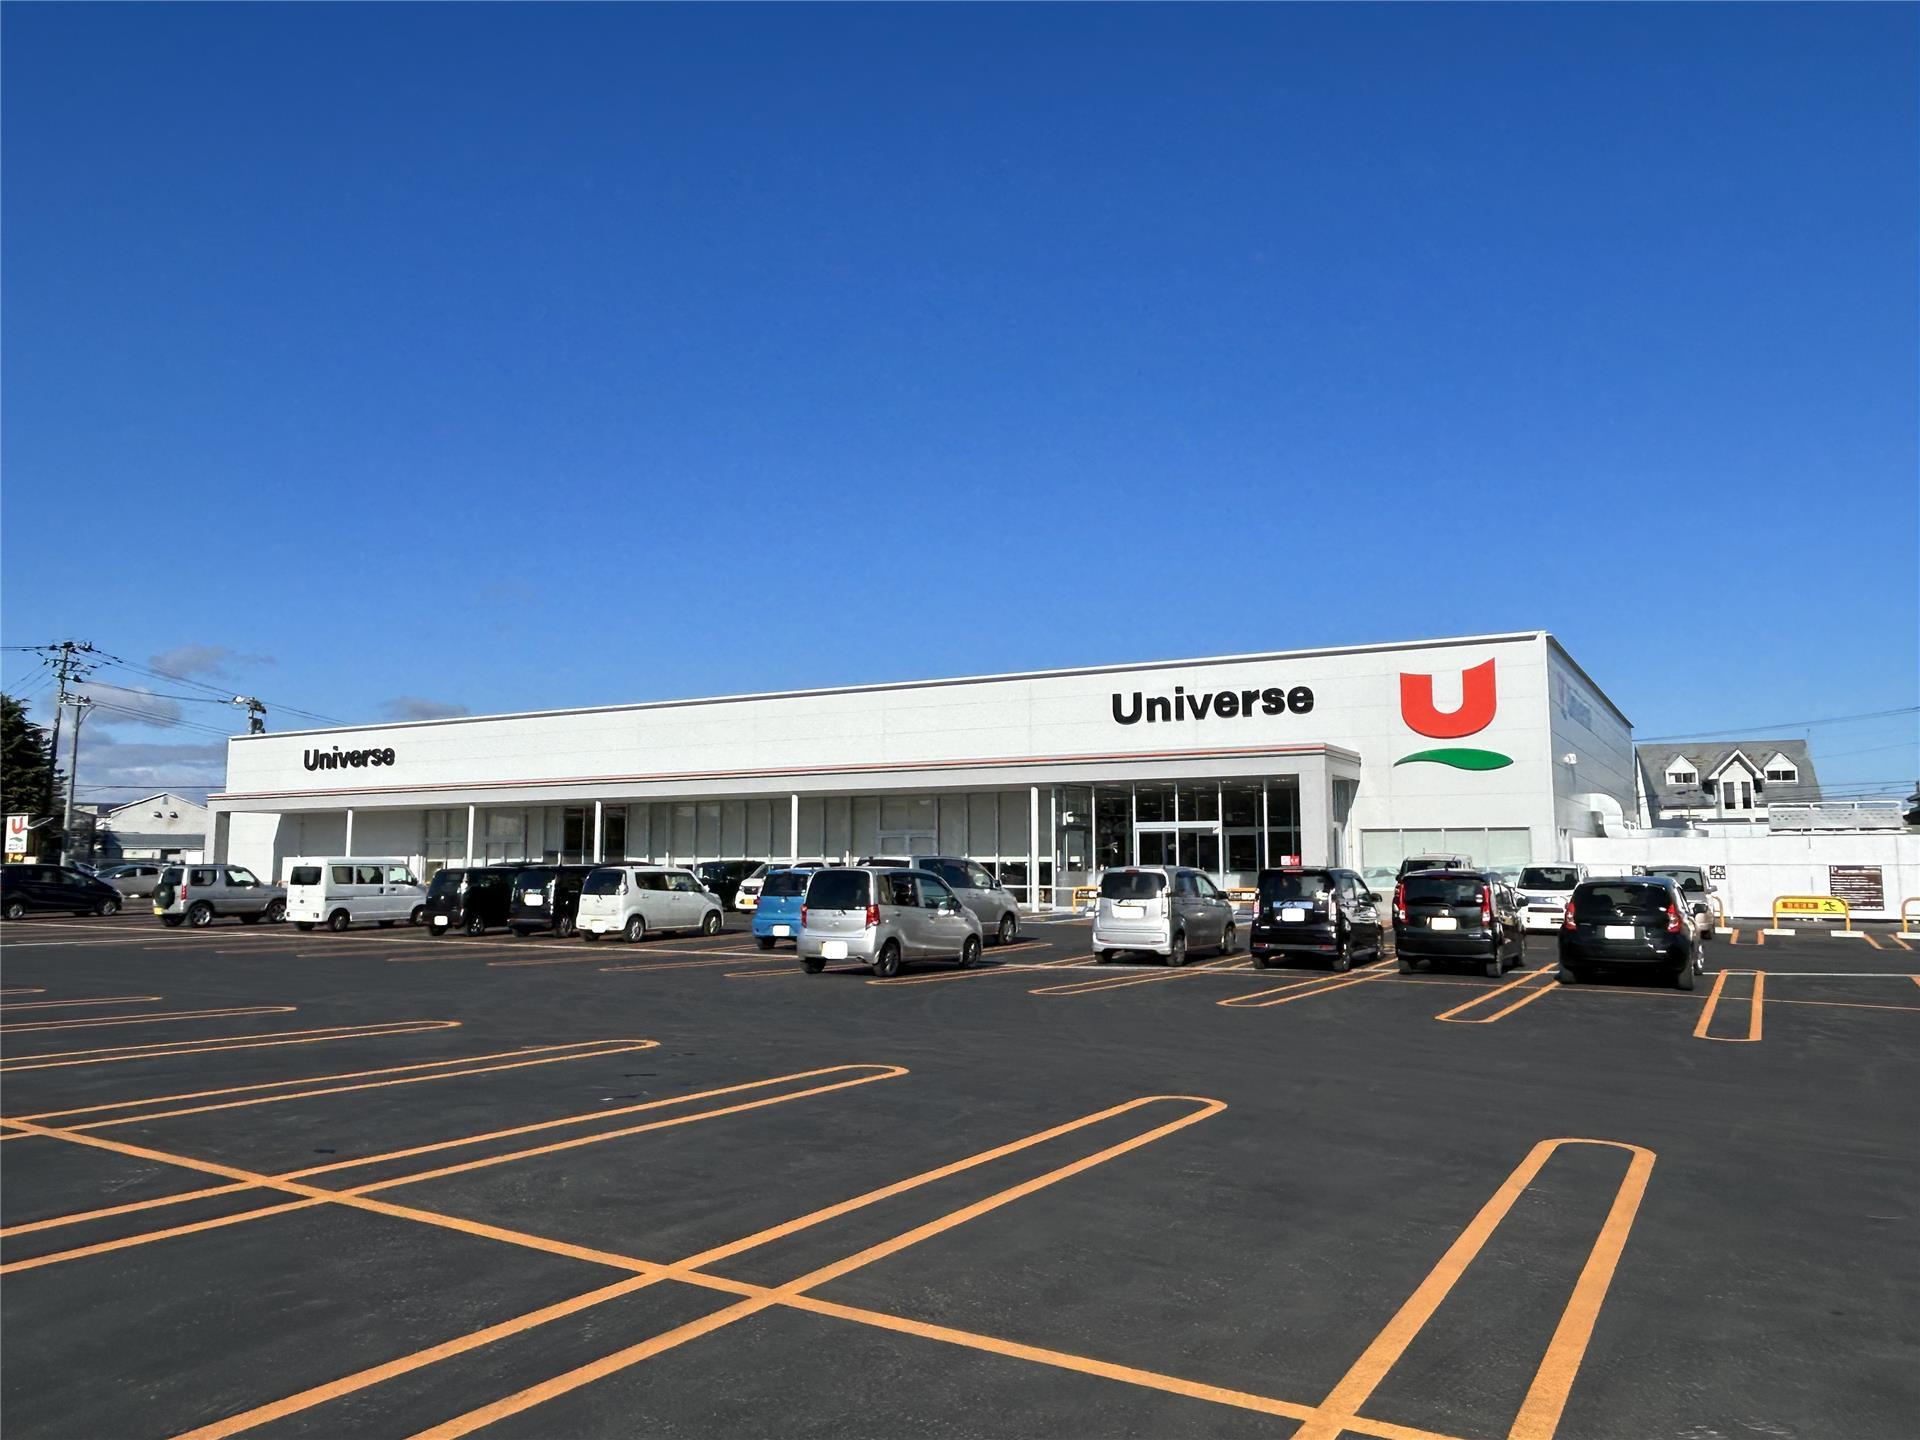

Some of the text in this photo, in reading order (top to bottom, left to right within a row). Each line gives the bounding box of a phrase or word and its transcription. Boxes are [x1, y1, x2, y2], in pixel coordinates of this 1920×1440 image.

[1112, 686, 1314, 725] Universe
[1400, 657, 1496, 738] U
[304, 745, 396, 771] Universe
[12, 816, 24, 834] U
